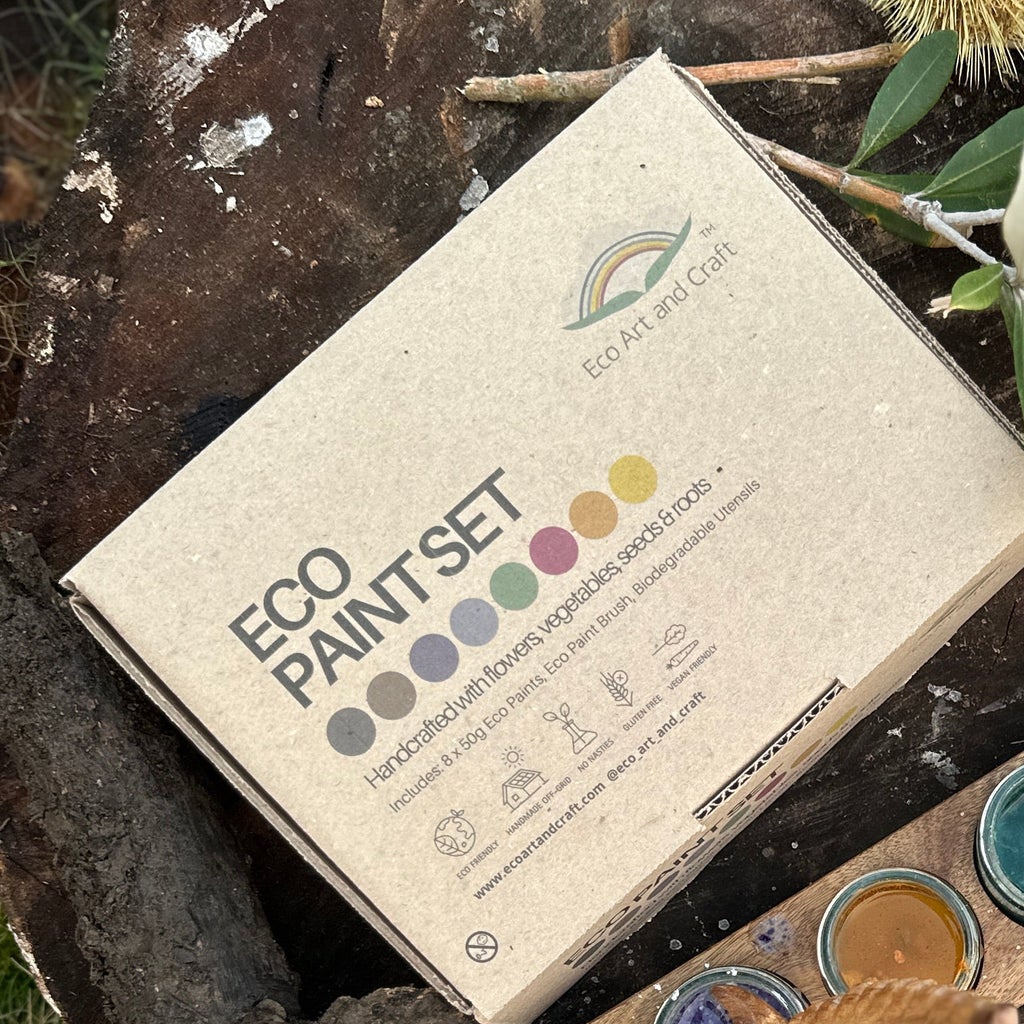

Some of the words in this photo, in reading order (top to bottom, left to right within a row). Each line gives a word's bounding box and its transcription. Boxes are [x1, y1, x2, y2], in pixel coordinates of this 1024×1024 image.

[582, 346, 620, 379] Eco
[620, 317, 654, 350] Art
[653, 280, 689, 320] and
[687, 241, 738, 286] Craft
[228, 547, 351, 663] ECO
[271, 548, 430, 709] PAINT
[419, 467, 522, 577] SET
[363, 702, 459, 789] Handcrafted
[453, 679, 491, 710] with
[483, 632, 544, 683] flowers,
[537, 562, 623, 634] vegetables,
[618, 521, 664, 565] seeds
[658, 509, 675, 526] &
[672, 478, 712, 516] roots
[388, 764, 444, 813] Includes:
[441, 754, 453, 766] 8
[451, 748, 463, 759] x
[459, 727, 487, 750] 50g
[483, 707, 508, 730] Eco
[506, 674, 547, 709] Paints,
[544, 652, 569, 675] Eco
[567, 624, 600, 654] Paint
[596, 594, 636, 628] Brush,
[632, 520, 716, 595] Biodegradable
[713, 480, 761, 522] Utensils
[667, 670, 691, 691] VEGAN
[689, 643, 718, 672] FRIENDLY
[577, 760, 590, 773] NO
[587, 738, 614, 762] NASTIES
[622, 710, 647, 732] GLUTEN
[646, 694, 663, 711] FREE
[473, 782, 606, 900] www.ecoartandcraft.com
[607, 691, 706, 782] @eco_art_and_craft
[505, 802, 542, 836] HANDMADE
[542, 776, 572, 804] OFF-GRID
[456, 866, 471, 880] ECO
[470, 840, 500, 868] FRIENDLY
